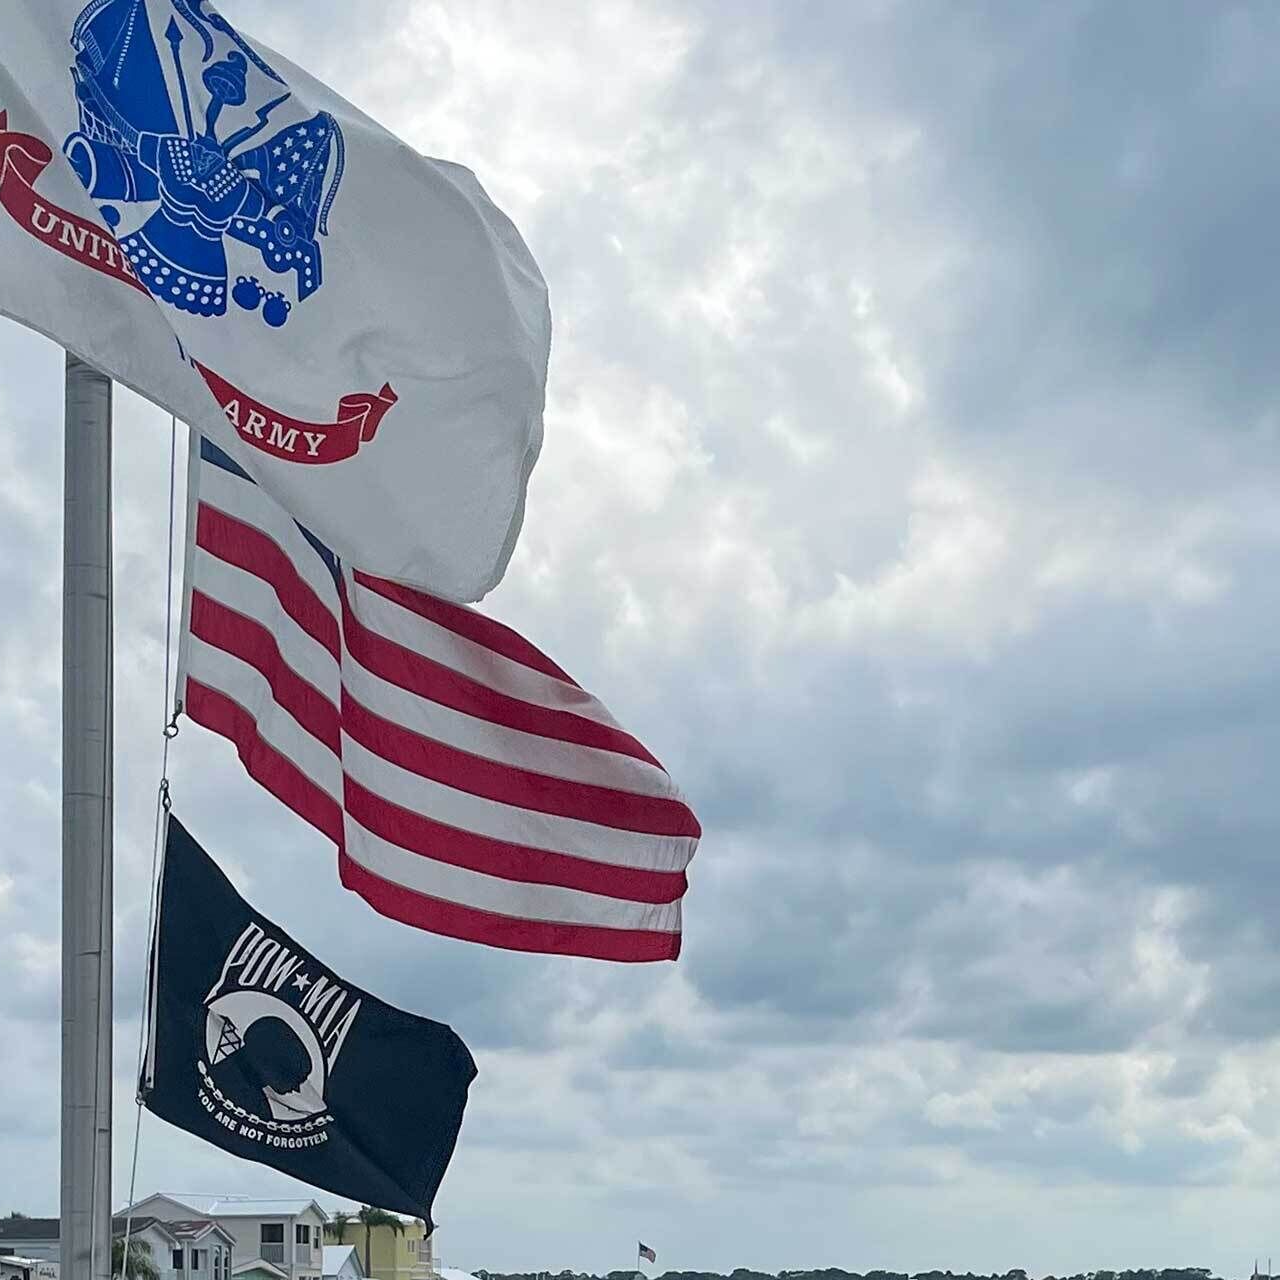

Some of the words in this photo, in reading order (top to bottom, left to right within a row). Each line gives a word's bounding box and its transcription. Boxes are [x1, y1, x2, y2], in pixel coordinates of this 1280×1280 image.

[223, 399, 327, 457] ARMY
[203, 922, 305, 1004] POW
[299, 976, 362, 1078] MIA
[197, 1088, 216, 1112] YOU
[215, 1112, 238, 1131] ARE
[239, 1125, 264, 1141] NOT
[266, 1131, 328, 1149] FORGOTTEN
